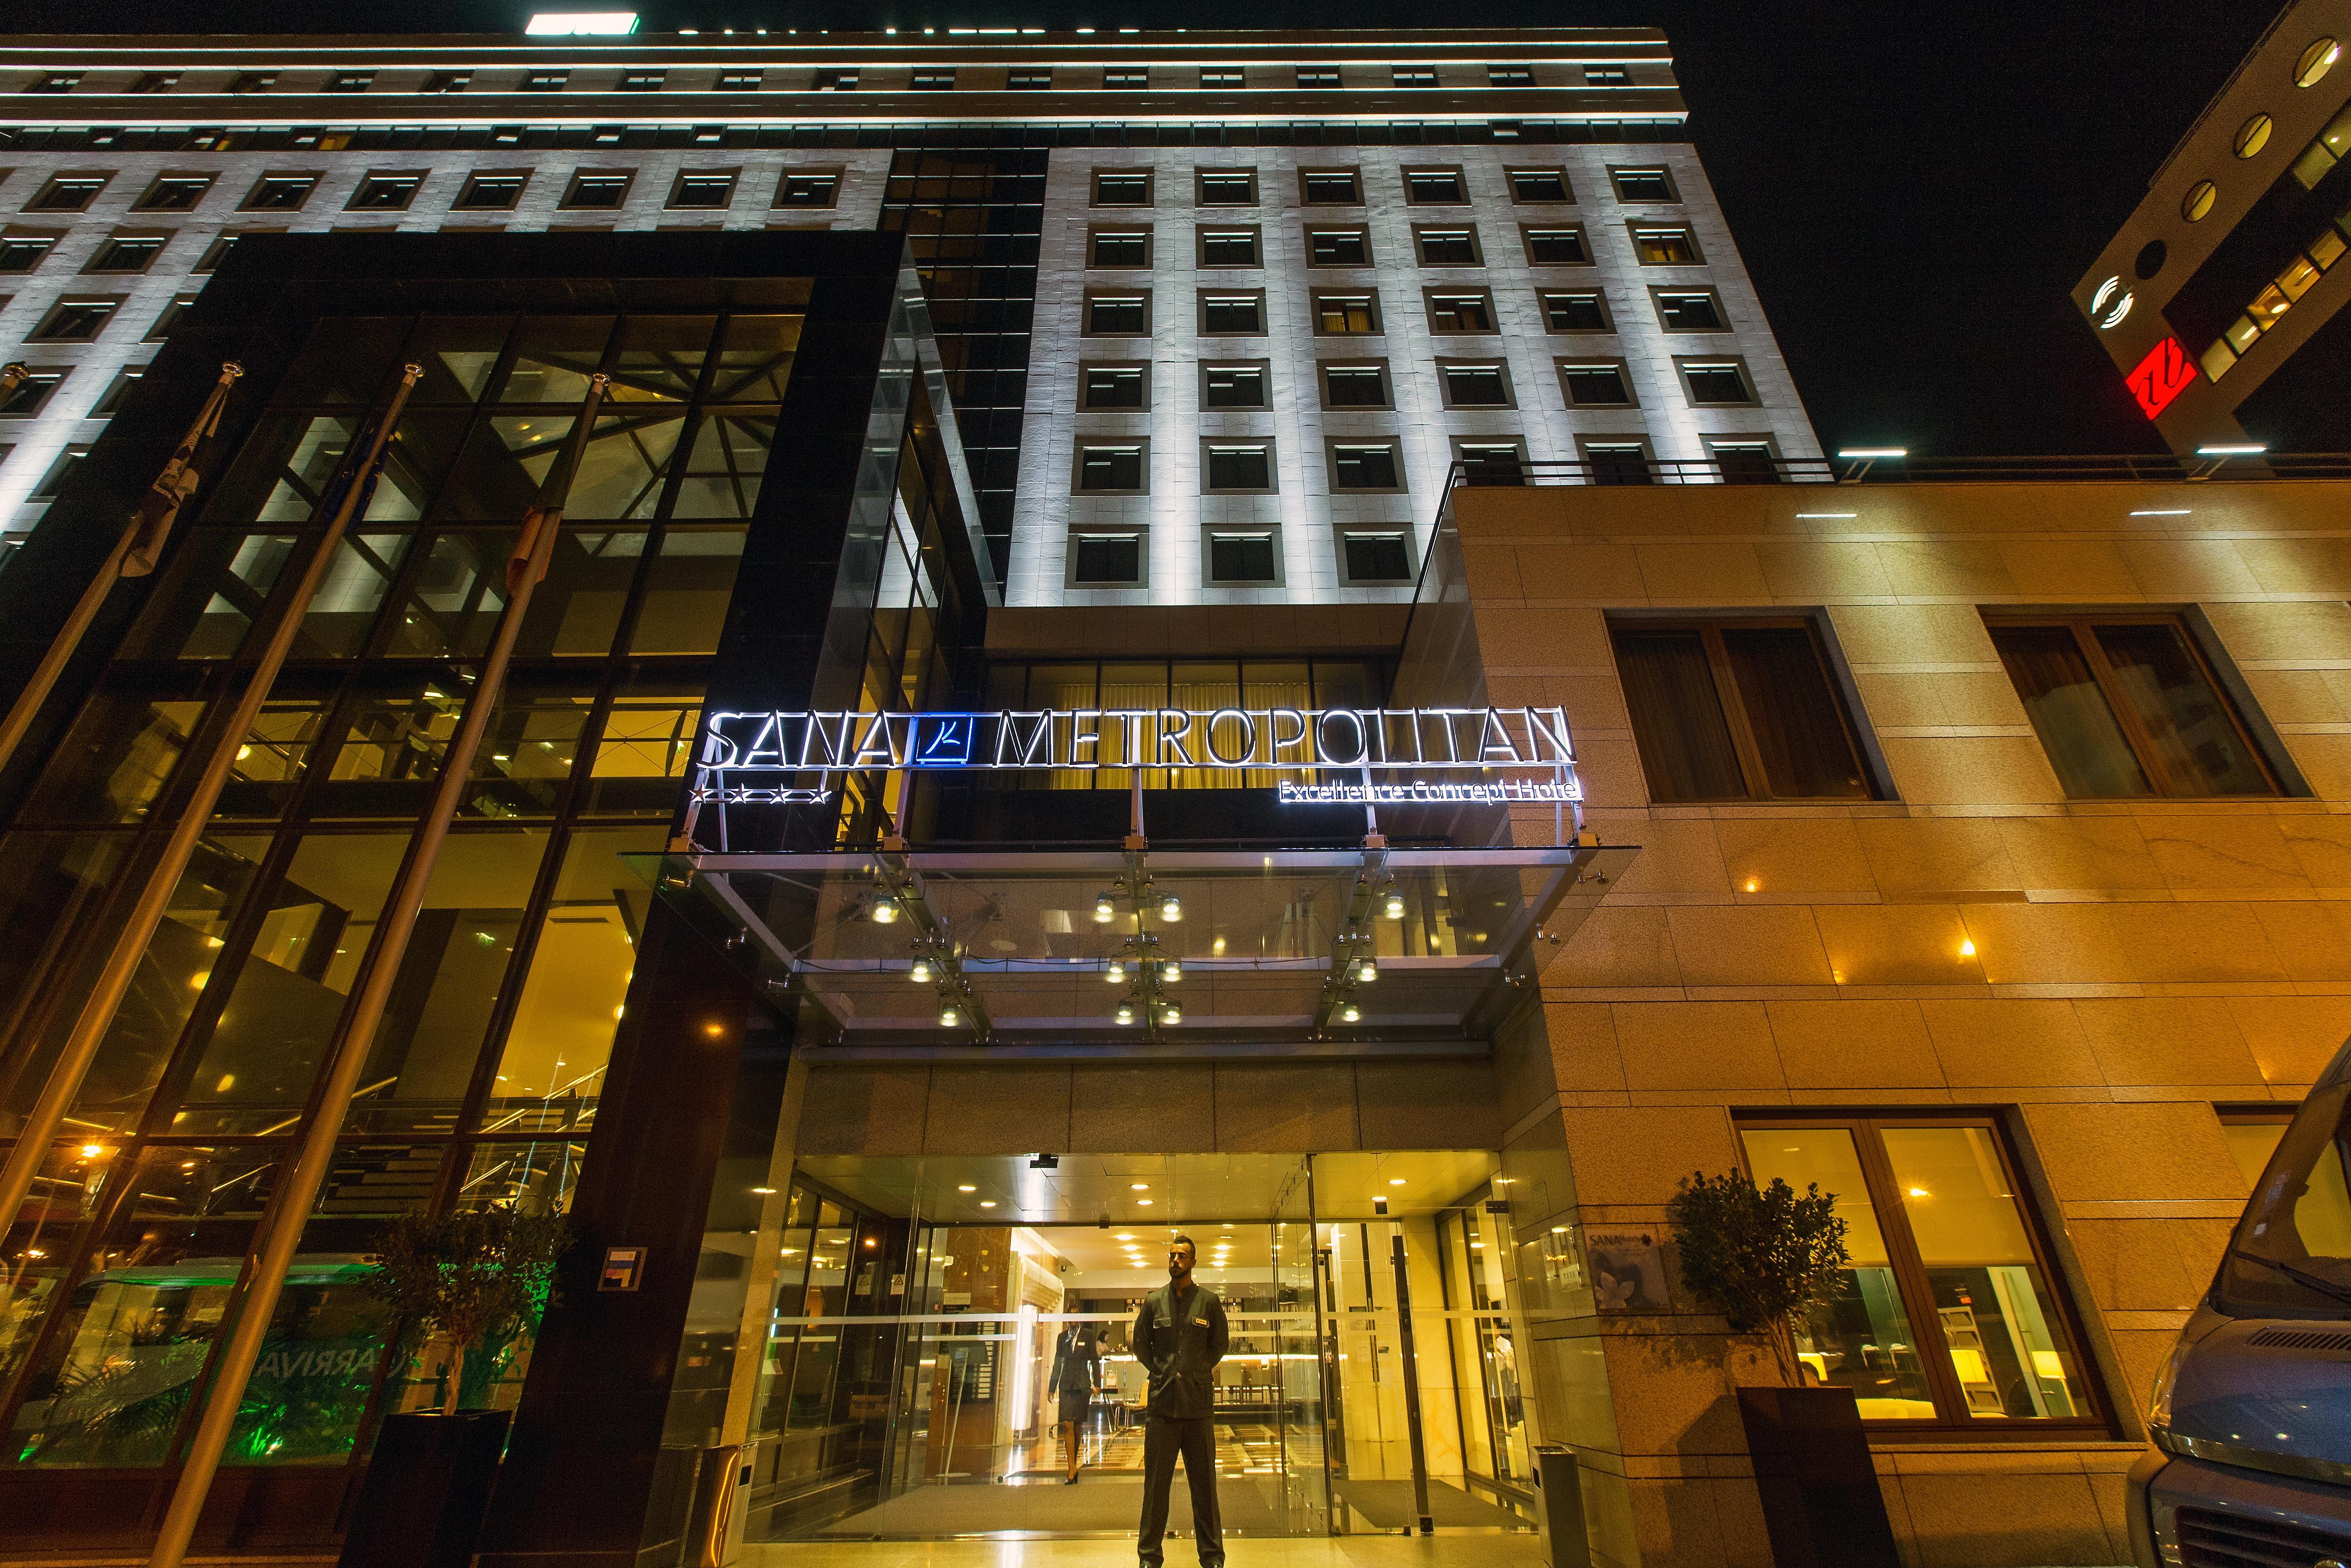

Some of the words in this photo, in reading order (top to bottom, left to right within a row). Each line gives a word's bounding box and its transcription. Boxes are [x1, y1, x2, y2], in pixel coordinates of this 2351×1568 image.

[697, 709, 896, 769] SANA
[992, 705, 1577, 768] METROPOLITAN
[1278, 779, 1405, 803] Excellence
[1411, 778, 1508, 806] Concept
[1516, 776, 1584, 803] Hotel
[1590, 1234, 1622, 1246] SANA
